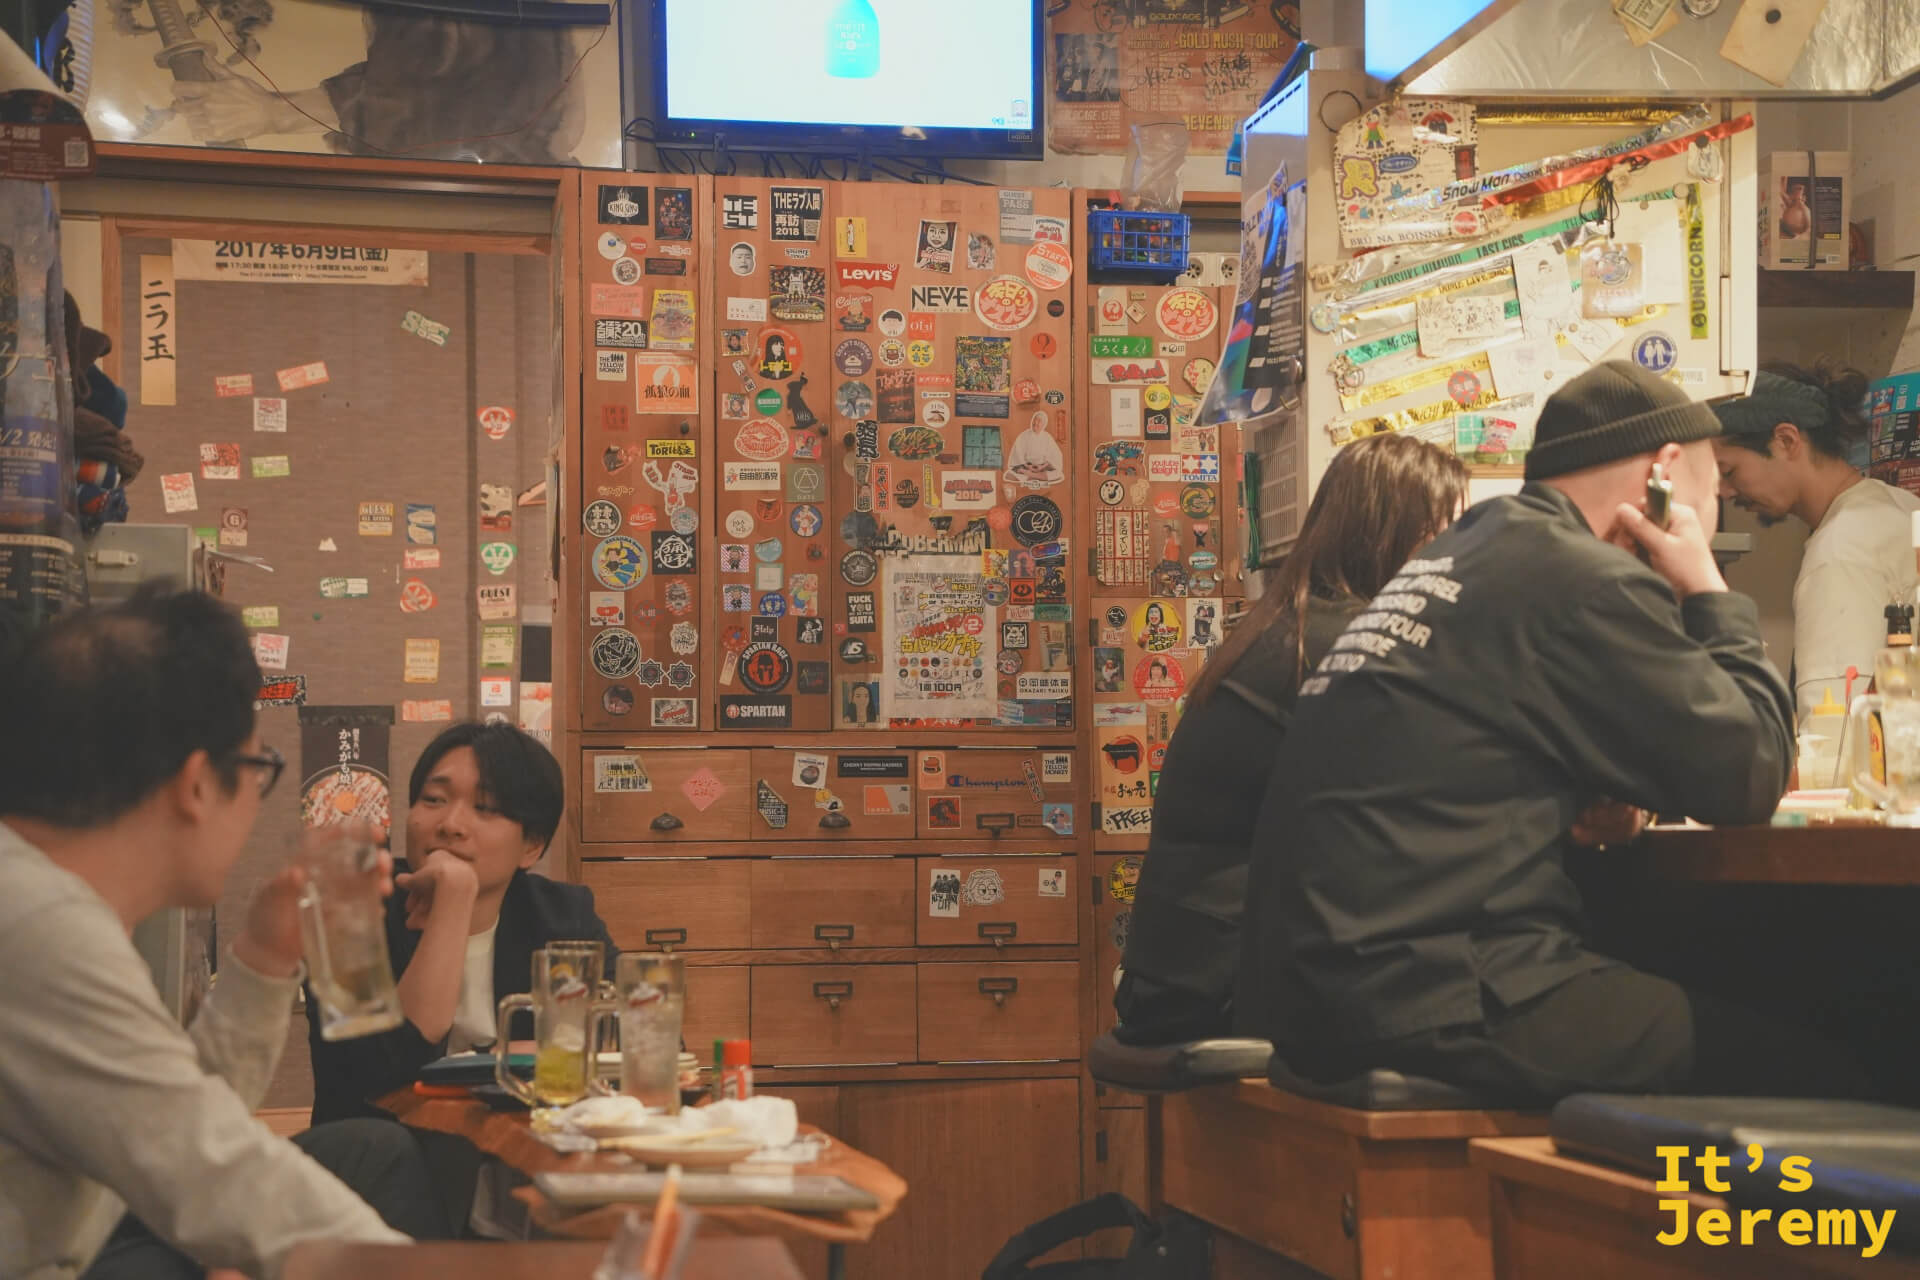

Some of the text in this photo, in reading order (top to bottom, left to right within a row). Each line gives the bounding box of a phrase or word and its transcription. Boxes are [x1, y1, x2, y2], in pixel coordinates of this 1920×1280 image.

[1442, 184, 1479, 201] Snow
[1481, 173, 1510, 192] Man
[773, 191, 820, 210] THEラブ人間
[1003, 199, 1030, 208] PASS
[775, 227, 800, 236] 2018
[911, 286, 969, 309] NEVE
[144, 280, 176, 361] ニラ玉
[1093, 345, 1129, 354] しろくま
[848, 595, 872, 603] FUCK
[849, 603, 872, 611] YOU
[849, 615, 874, 624] SUITA
[742, 641, 789, 660] SPARTAN RACE
[740, 705, 786, 717] SPARTAN
[947, 774, 1026, 791] Champion
